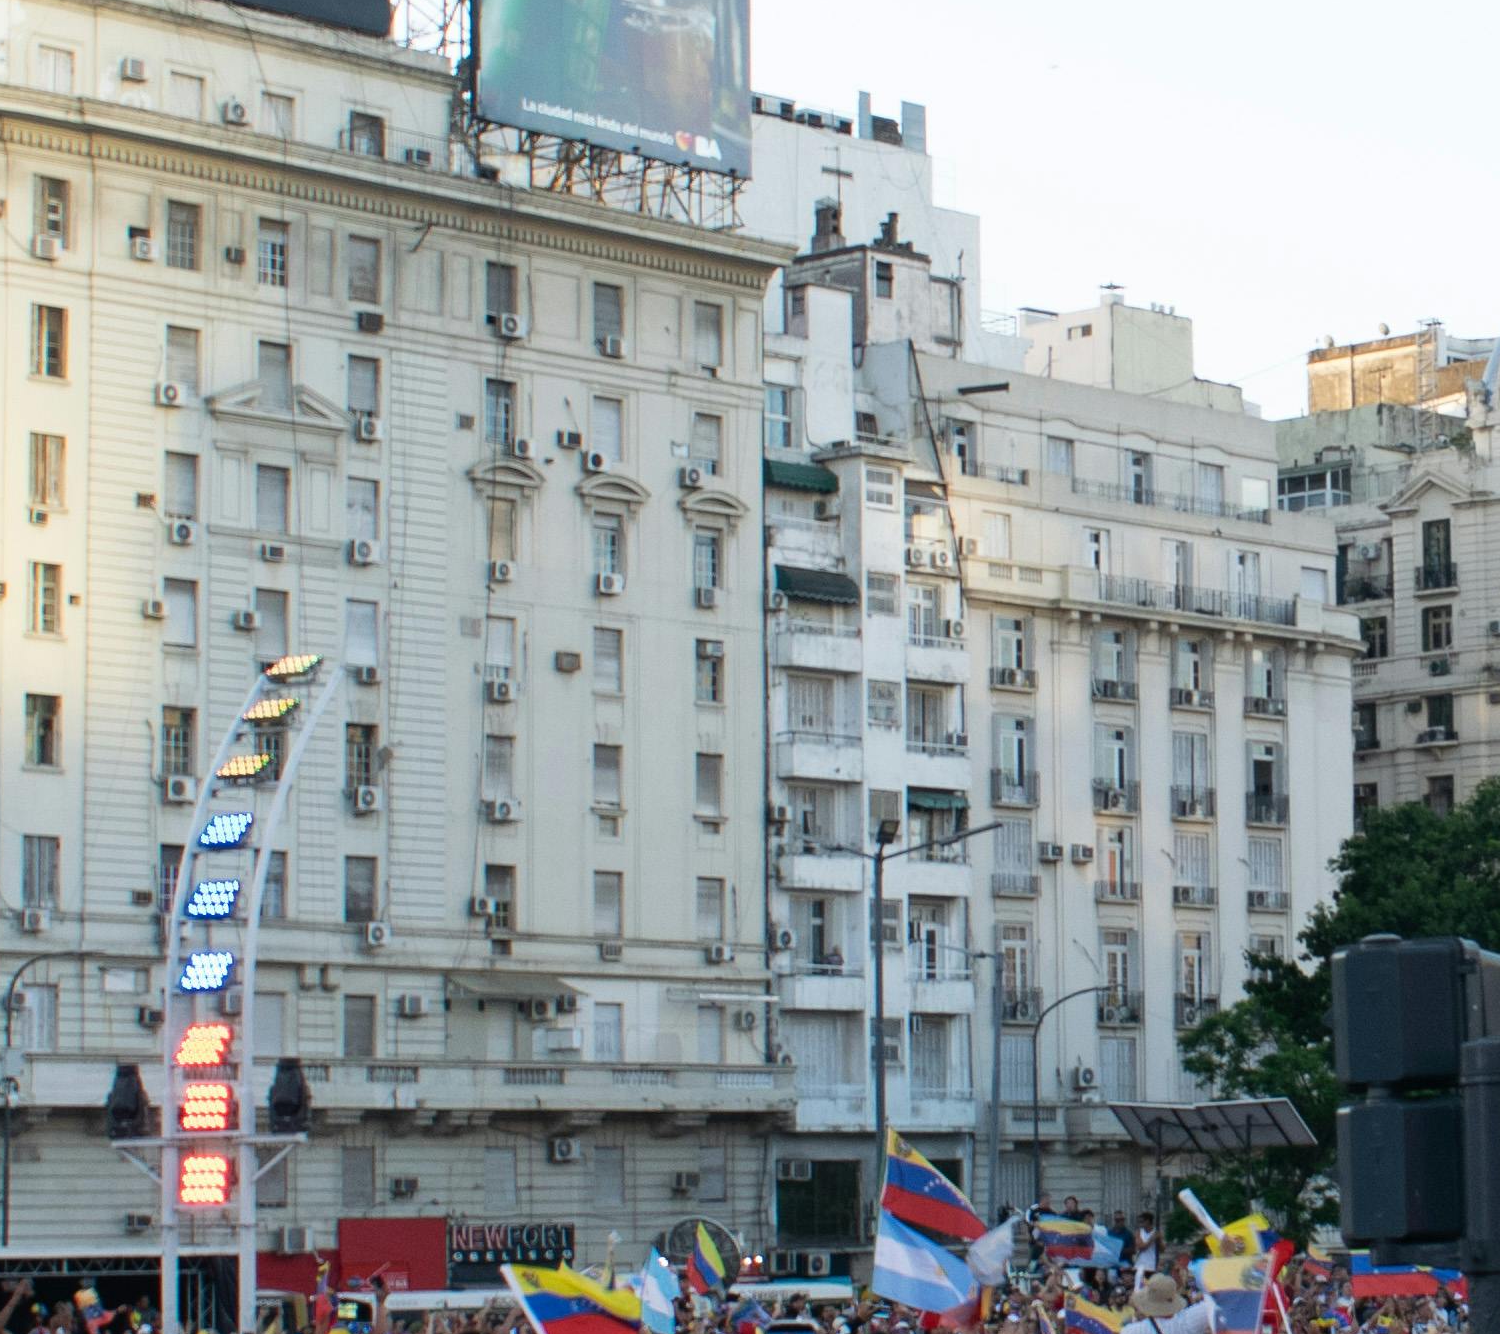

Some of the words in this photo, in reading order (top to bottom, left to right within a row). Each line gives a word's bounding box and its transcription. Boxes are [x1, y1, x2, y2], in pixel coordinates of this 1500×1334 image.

[521, 97, 536, 113] La
[537, 101, 572, 122] ciudad
[695, 135, 722, 161] BA
[451, 1224, 573, 1250] NEWPORT
